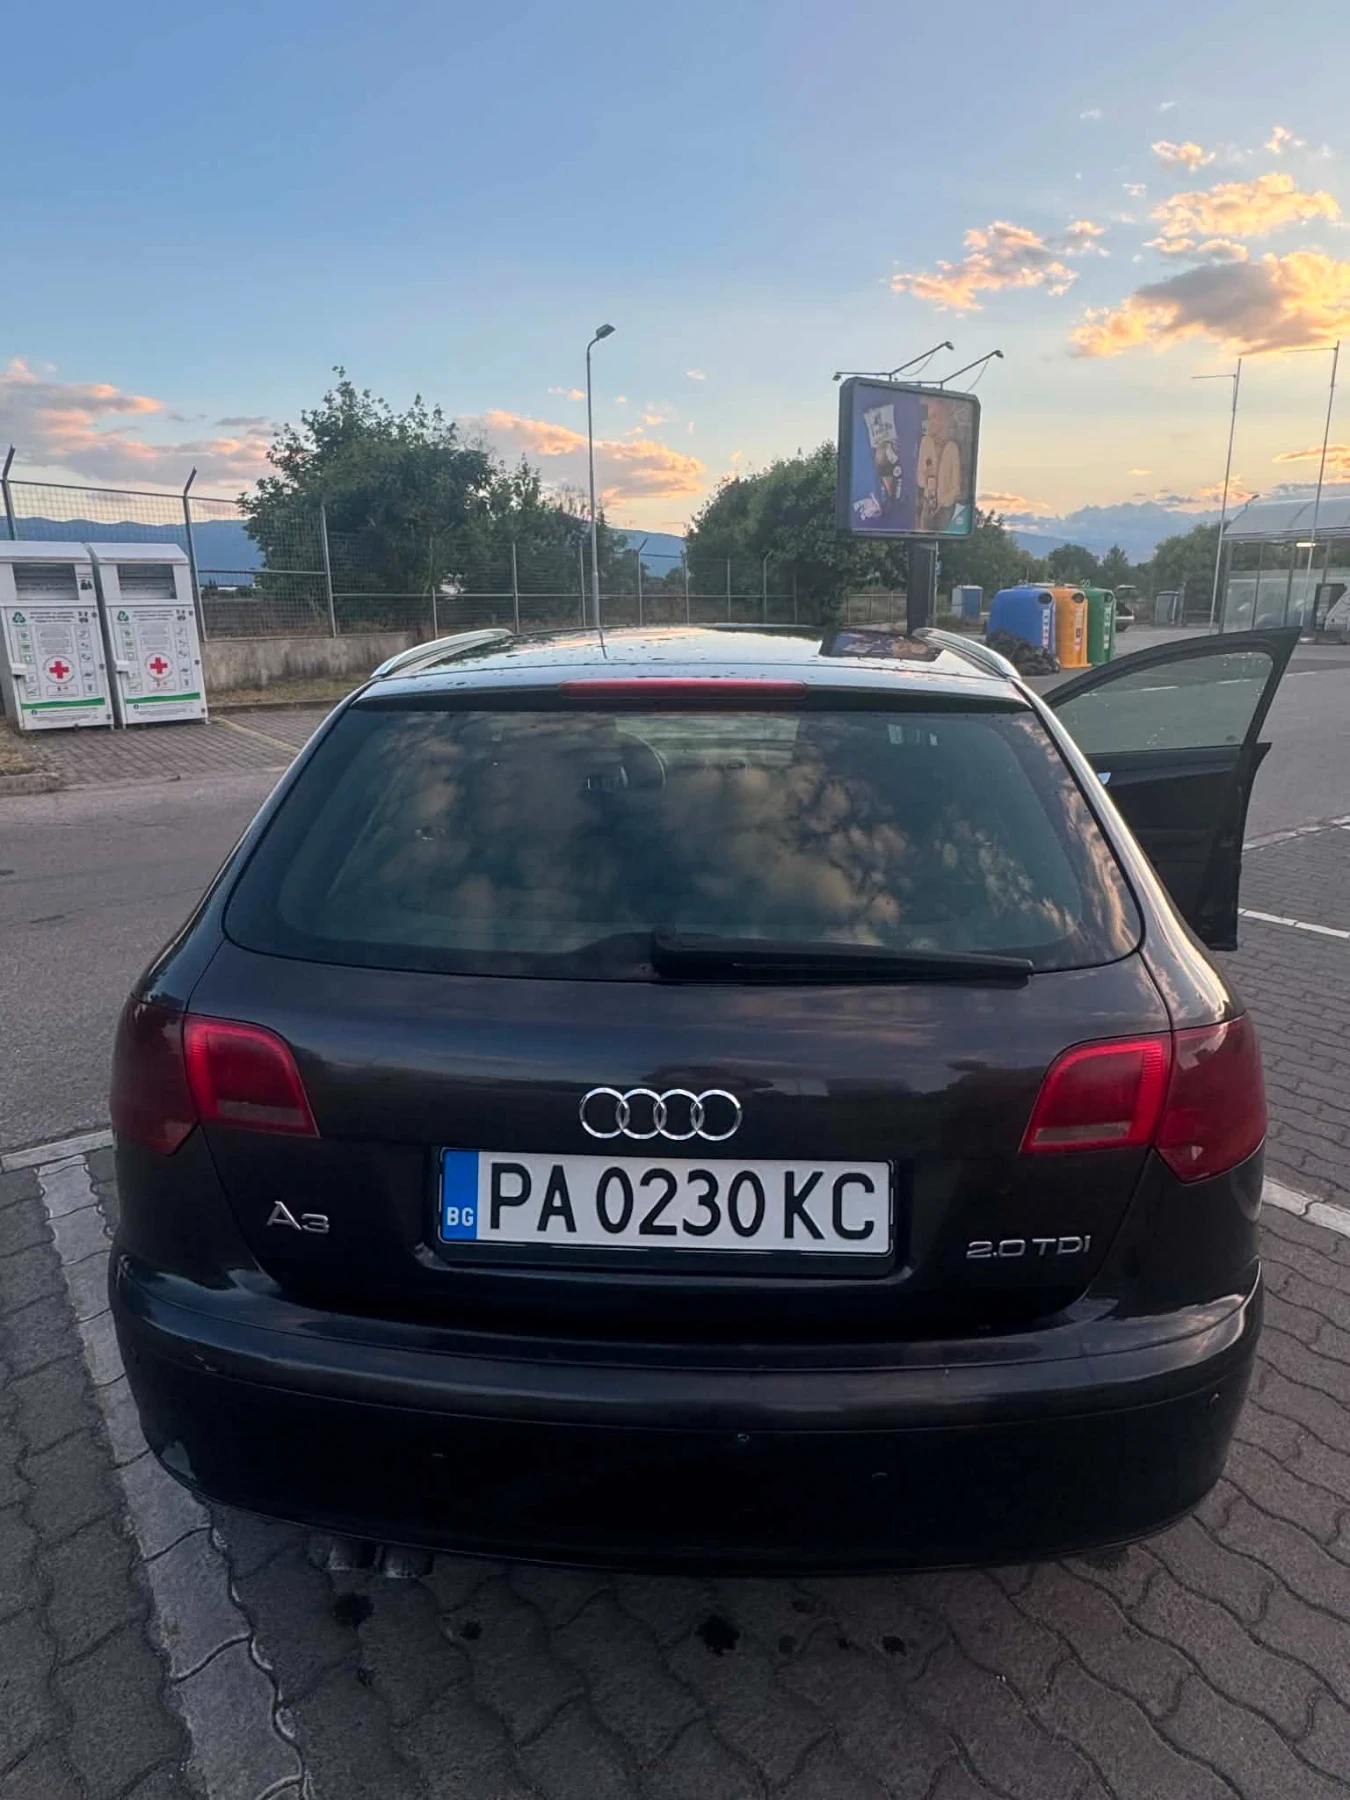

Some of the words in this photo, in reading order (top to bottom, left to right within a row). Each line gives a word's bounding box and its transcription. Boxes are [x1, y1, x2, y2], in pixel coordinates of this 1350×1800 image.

[490, 1162, 577, 1233] PA
[596, 1166, 766, 1238] 0230
[784, 1171, 875, 1240] KC
[266, 1200, 330, 1234] A3
[446, 1206, 474, 1227] BG
[966, 1239, 1026, 1259] 2.0
